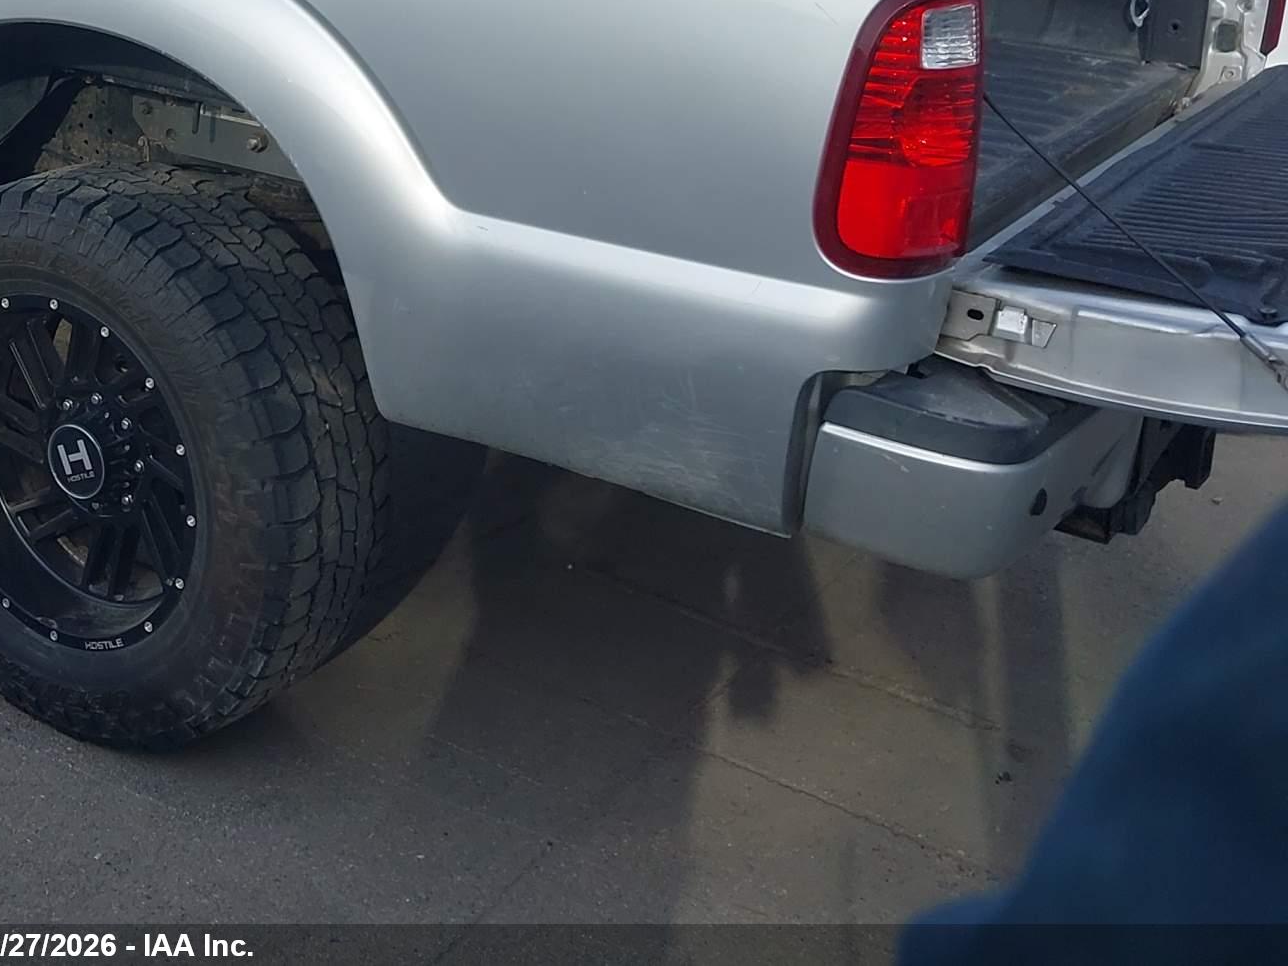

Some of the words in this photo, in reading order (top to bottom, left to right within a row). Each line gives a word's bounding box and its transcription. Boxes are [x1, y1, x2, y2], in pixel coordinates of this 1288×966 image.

[57, 439, 93, 476] H
[66, 470, 95, 483] HOSTILE
[84, 637, 125, 651] HOSTILE
